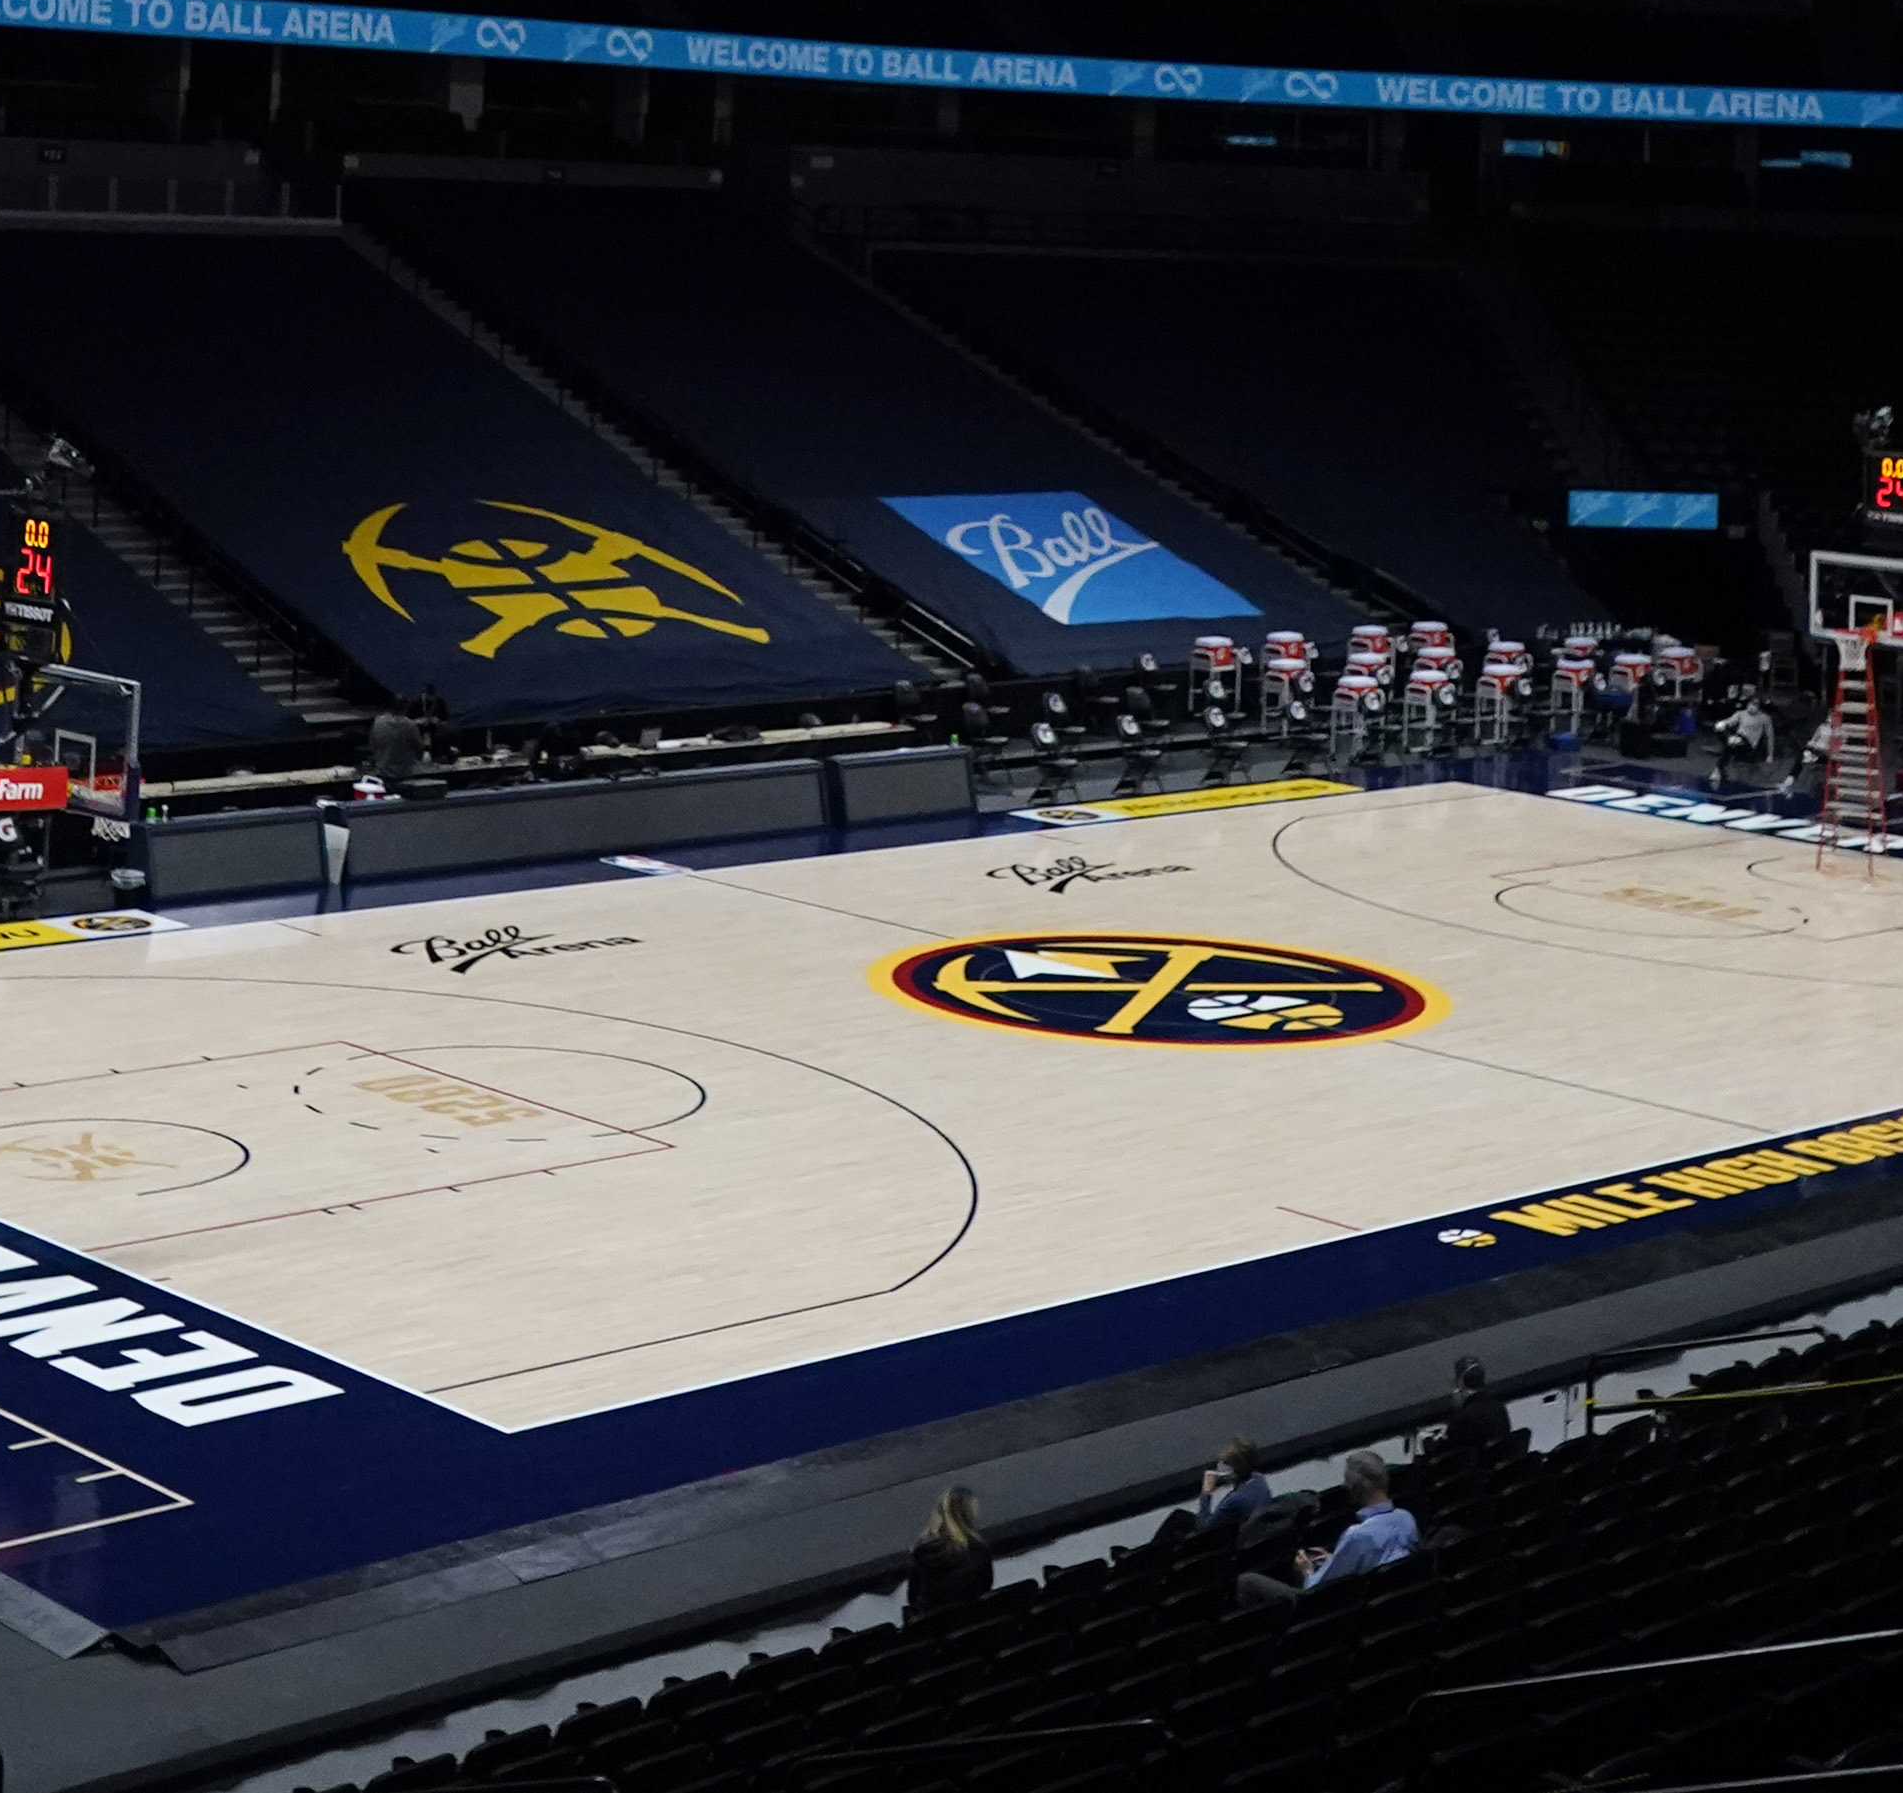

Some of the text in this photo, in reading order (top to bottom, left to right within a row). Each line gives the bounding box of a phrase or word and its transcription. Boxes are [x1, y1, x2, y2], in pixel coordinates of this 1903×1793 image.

[185, 0, 274, 38] BALL
[282, 8, 397, 46] ARENA
[686, 36, 1079, 89] WELCOME TO BALL ARENA
[1376, 76, 1825, 123] WELCOME TO BALL ARENA
[24, 517, 50, 549] 0.0
[15, 547, 53, 595] 24
[946, 506, 1148, 610] Ball
[986, 856, 1102, 891] Ball
[390, 925, 646, 970] Ball Arena
[1488, 1182, 1698, 1238] MILE
[1658, 1139, 1838, 1202] HIGH
